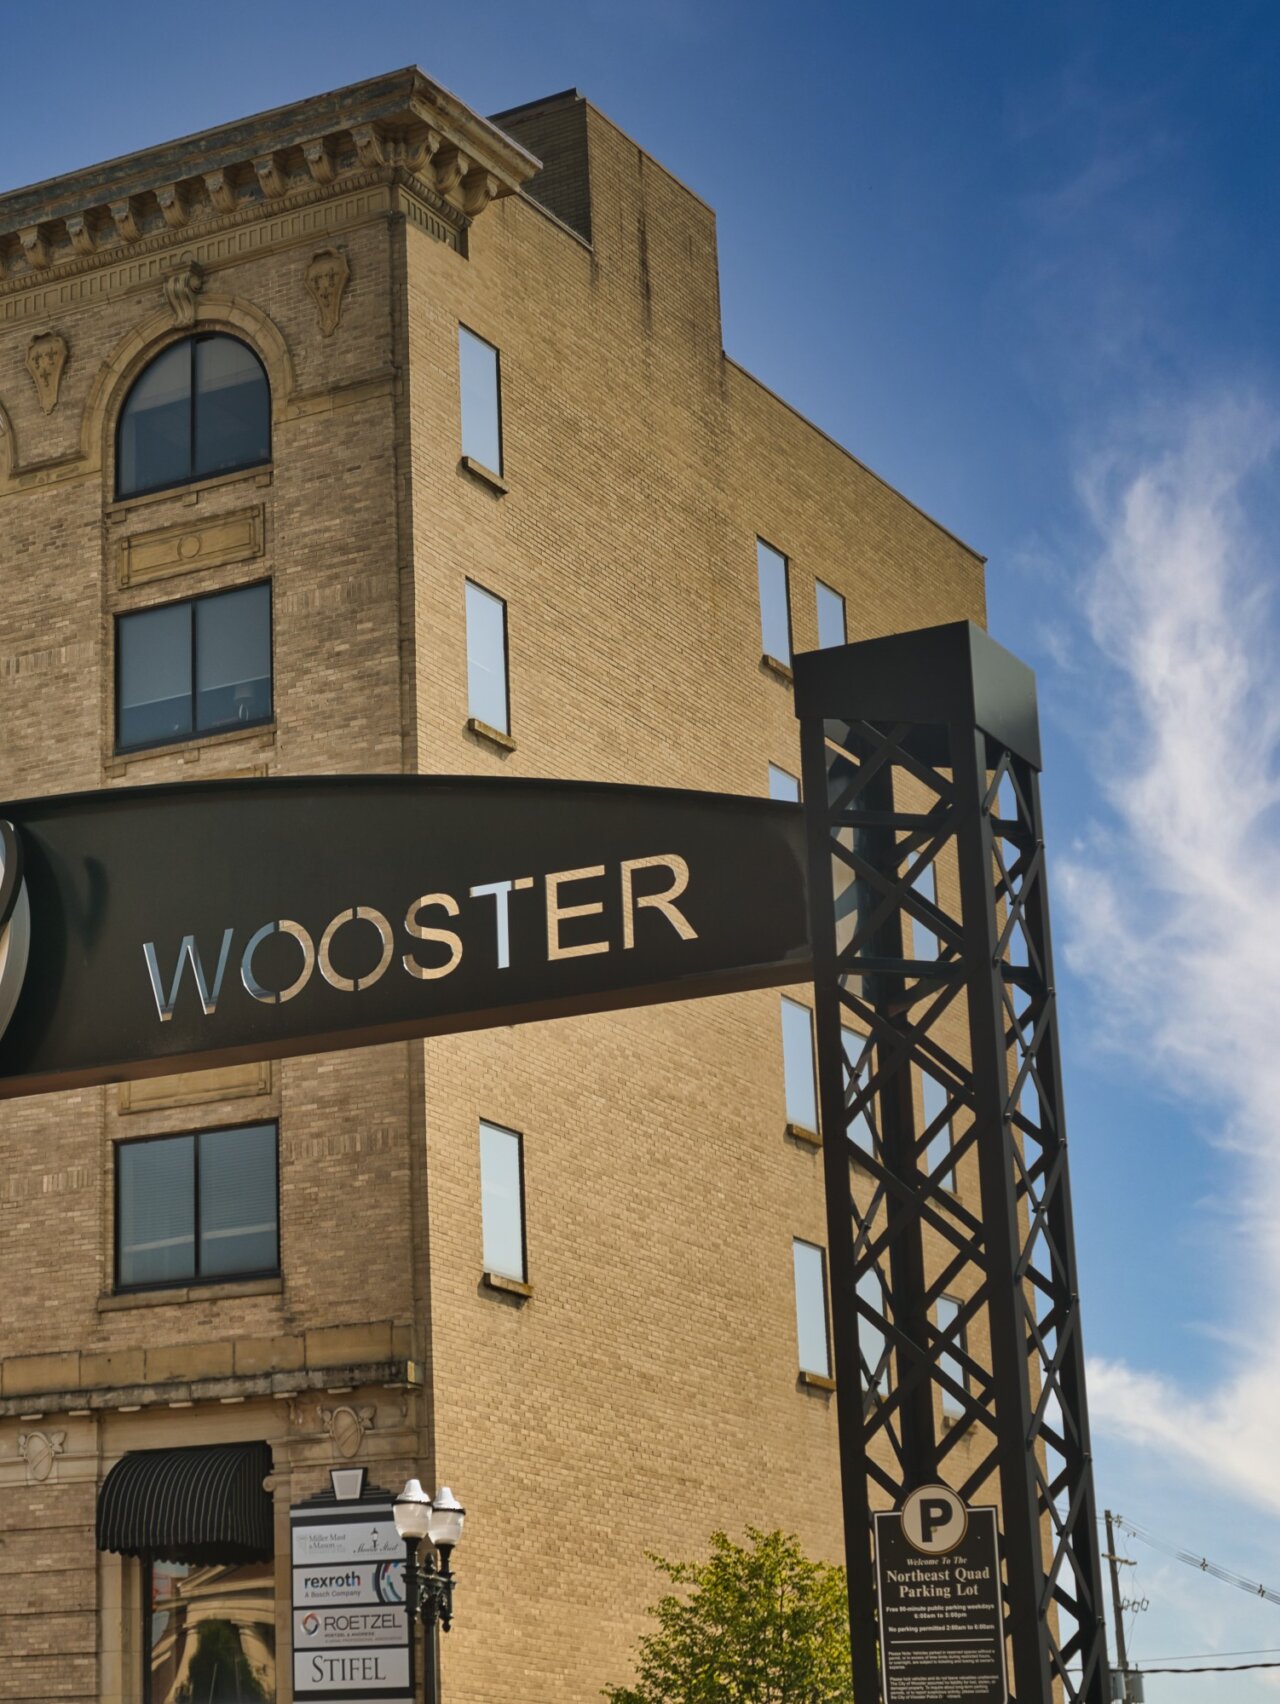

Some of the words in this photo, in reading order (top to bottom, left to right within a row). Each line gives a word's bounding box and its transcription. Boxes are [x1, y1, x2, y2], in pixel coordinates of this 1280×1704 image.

[142, 853, 699, 1022] WOOSTER
[919, 1497, 953, 1543] P
[907, 1558, 939, 1567] Welcome
[942, 1556, 951, 1565] To
[953, 1556, 967, 1564] The
[304, 1571, 361, 1589] rexroth
[886, 1568, 950, 1583] Northeast
[954, 1566, 990, 1583] Quad
[311, 1590, 330, 1598] Bosch
[331, 1590, 361, 1598] Company
[899, 1584, 952, 1599] Parking
[956, 1583, 979, 1596] Lot
[324, 1613, 402, 1631] ROETZEL
[311, 1655, 387, 1683] STIFEL
